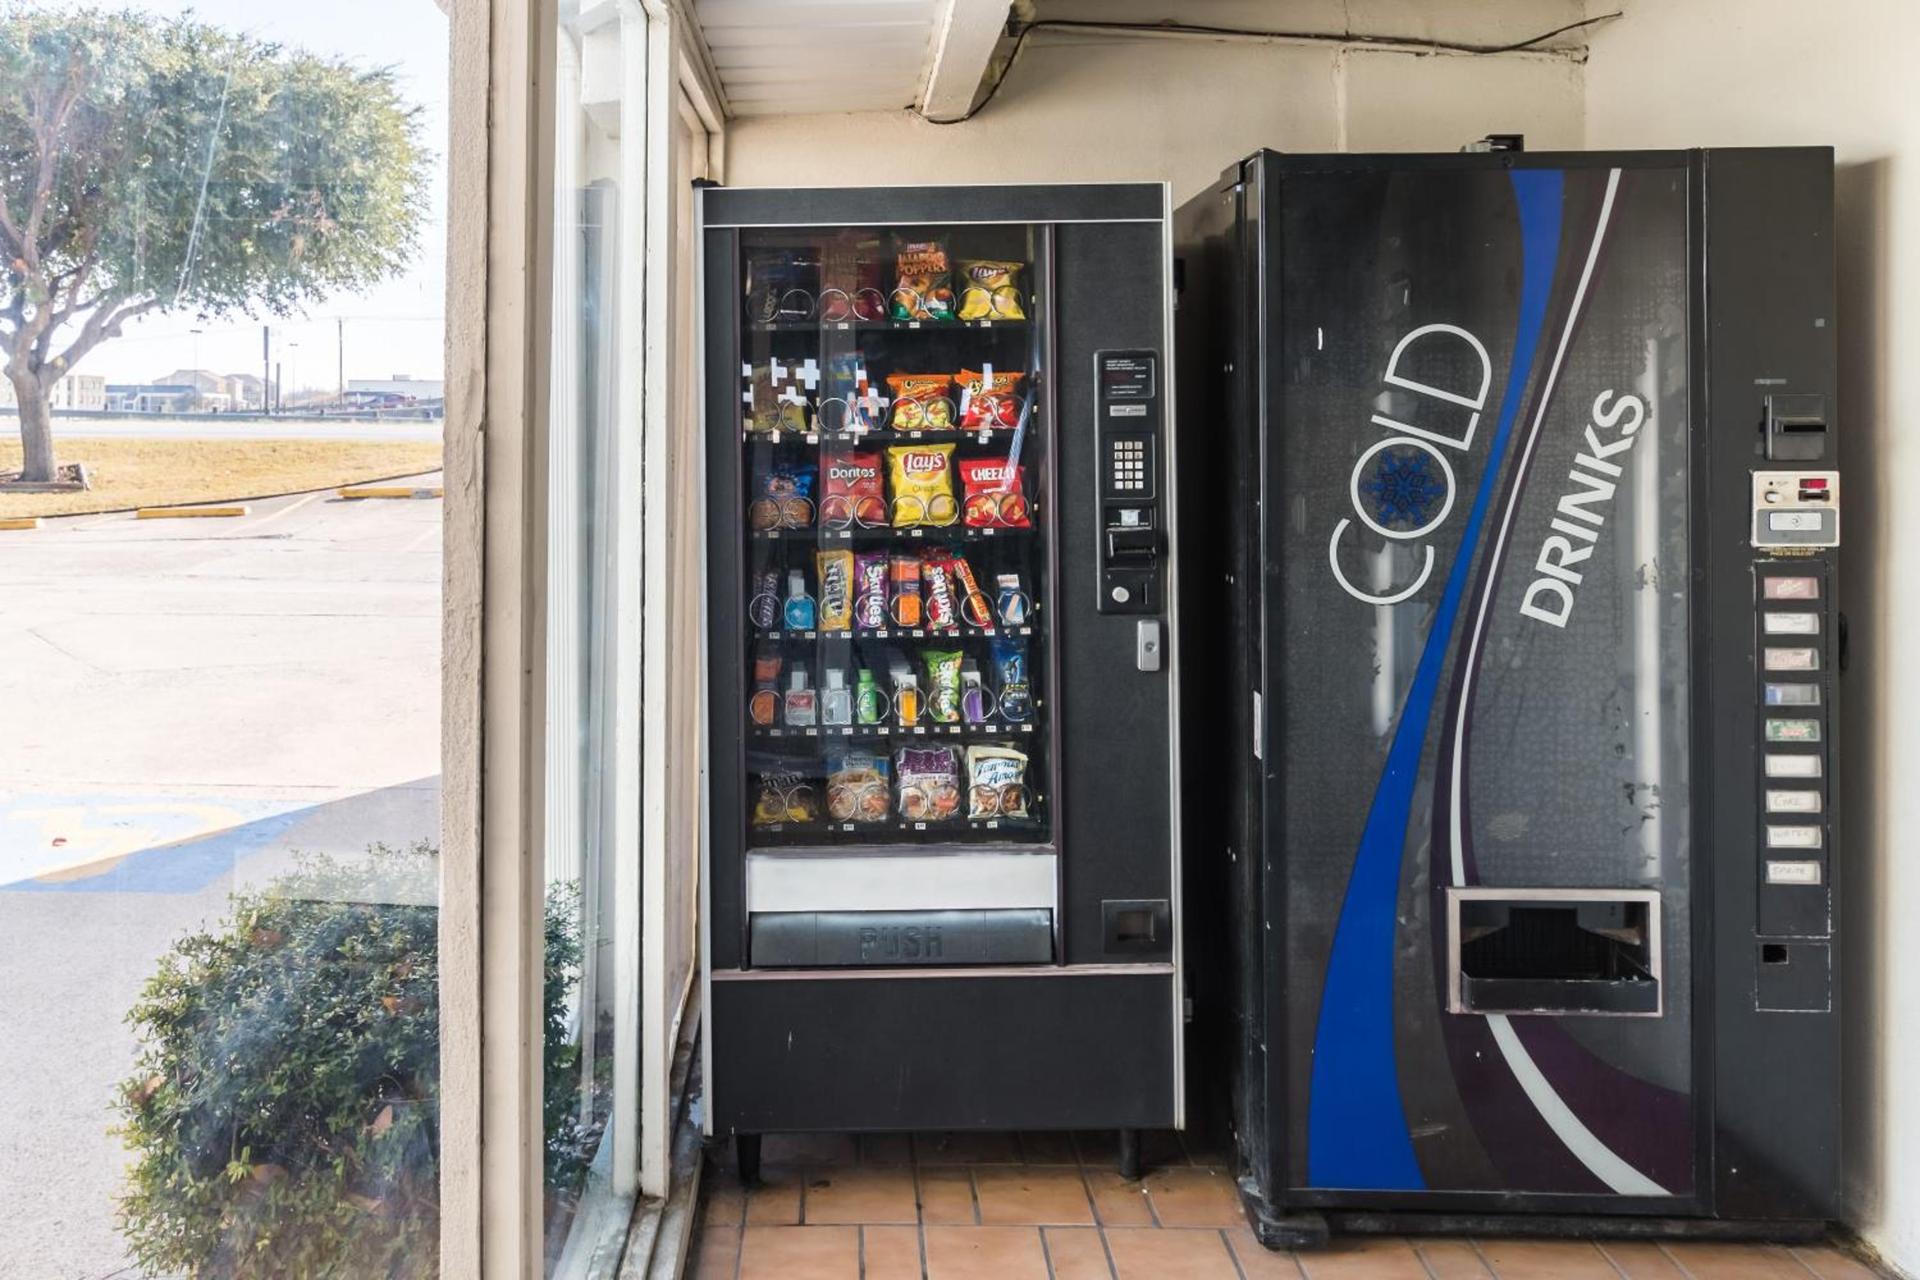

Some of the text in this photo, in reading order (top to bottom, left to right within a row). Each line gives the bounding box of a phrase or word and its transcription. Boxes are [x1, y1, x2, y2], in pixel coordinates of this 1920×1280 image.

[829, 467, 876, 479] Doritos
[971, 466, 1016, 481] CHEEZ
[1329, 323, 1492, 605] COLD
[1519, 388, 1645, 628] DRINKS
[859, 927, 942, 957] PUSH
